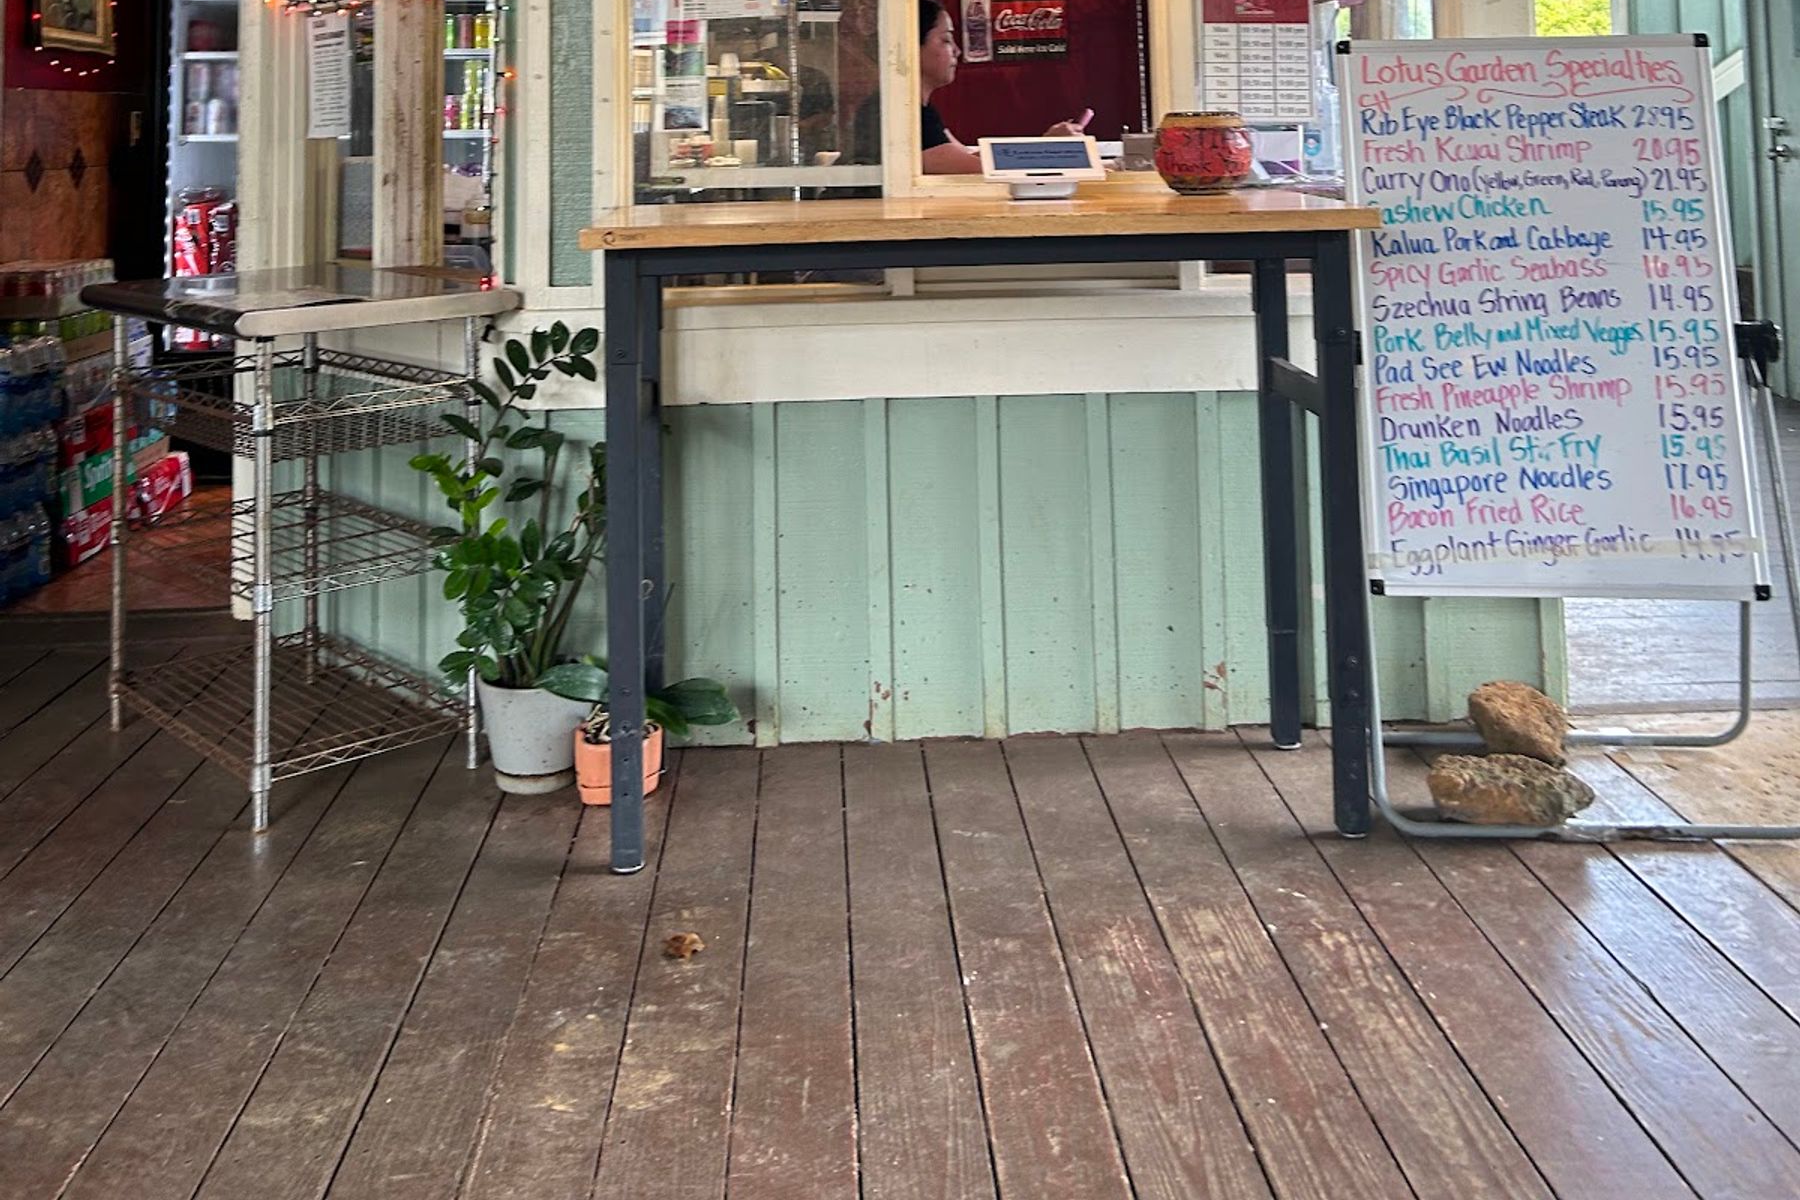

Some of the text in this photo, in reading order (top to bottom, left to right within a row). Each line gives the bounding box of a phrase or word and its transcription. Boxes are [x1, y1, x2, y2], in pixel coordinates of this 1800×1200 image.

[1361, 49, 1684, 90] Lotus Garden Specialties
[1361, 108, 1399, 136] Rib
[1402, 106, 1440, 141] Eye
[1444, 104, 1501, 131] Black
[1505, 103, 1567, 139] Pepper
[1568, 102, 1627, 129] Steak
[1363, 138, 1425, 163] Fresh
[1505, 134, 1593, 163] Shrimp
[1362, 166, 1425, 200] Curry
[1651, 168, 1708, 192] 21.95
[1368, 194, 1705, 225] ashew Chicken 15.95
[1371, 225, 1708, 258] Kalua Pork and Cabbage 14.95
[1370, 254, 1713, 292] Spicy Garlic Seabass 16.95
[1372, 284, 1714, 322] Szechua String Beans 14.95
[1374, 325, 1425, 353] Pork
[1434, 321, 1491, 351] Belly
[1497, 321, 1521, 343] and
[1526, 316, 1580, 342] Mixed
[1648, 318, 1720, 344] 15.95
[1375, 345, 1720, 385] Pad See Ew Noodles 15.95
[1376, 373, 1726, 414] Fresh Pineapple Shrimp 15.95
[1380, 403, 1725, 442] Drunken Noodles 15.95
[1378, 442, 1431, 472] Thai
[1439, 437, 1502, 468] Basil
[1661, 434, 1727, 461] 15.95
[1388, 472, 1507, 510] Singapore
[1520, 463, 1613, 491] Noodles
[1388, 493, 1734, 535] Bacon Fried Rice 16.95
[1391, 532, 1501, 576] Eggplant
[1504, 529, 1578, 567] Ginger
[1584, 524, 1655, 556] Garlic
